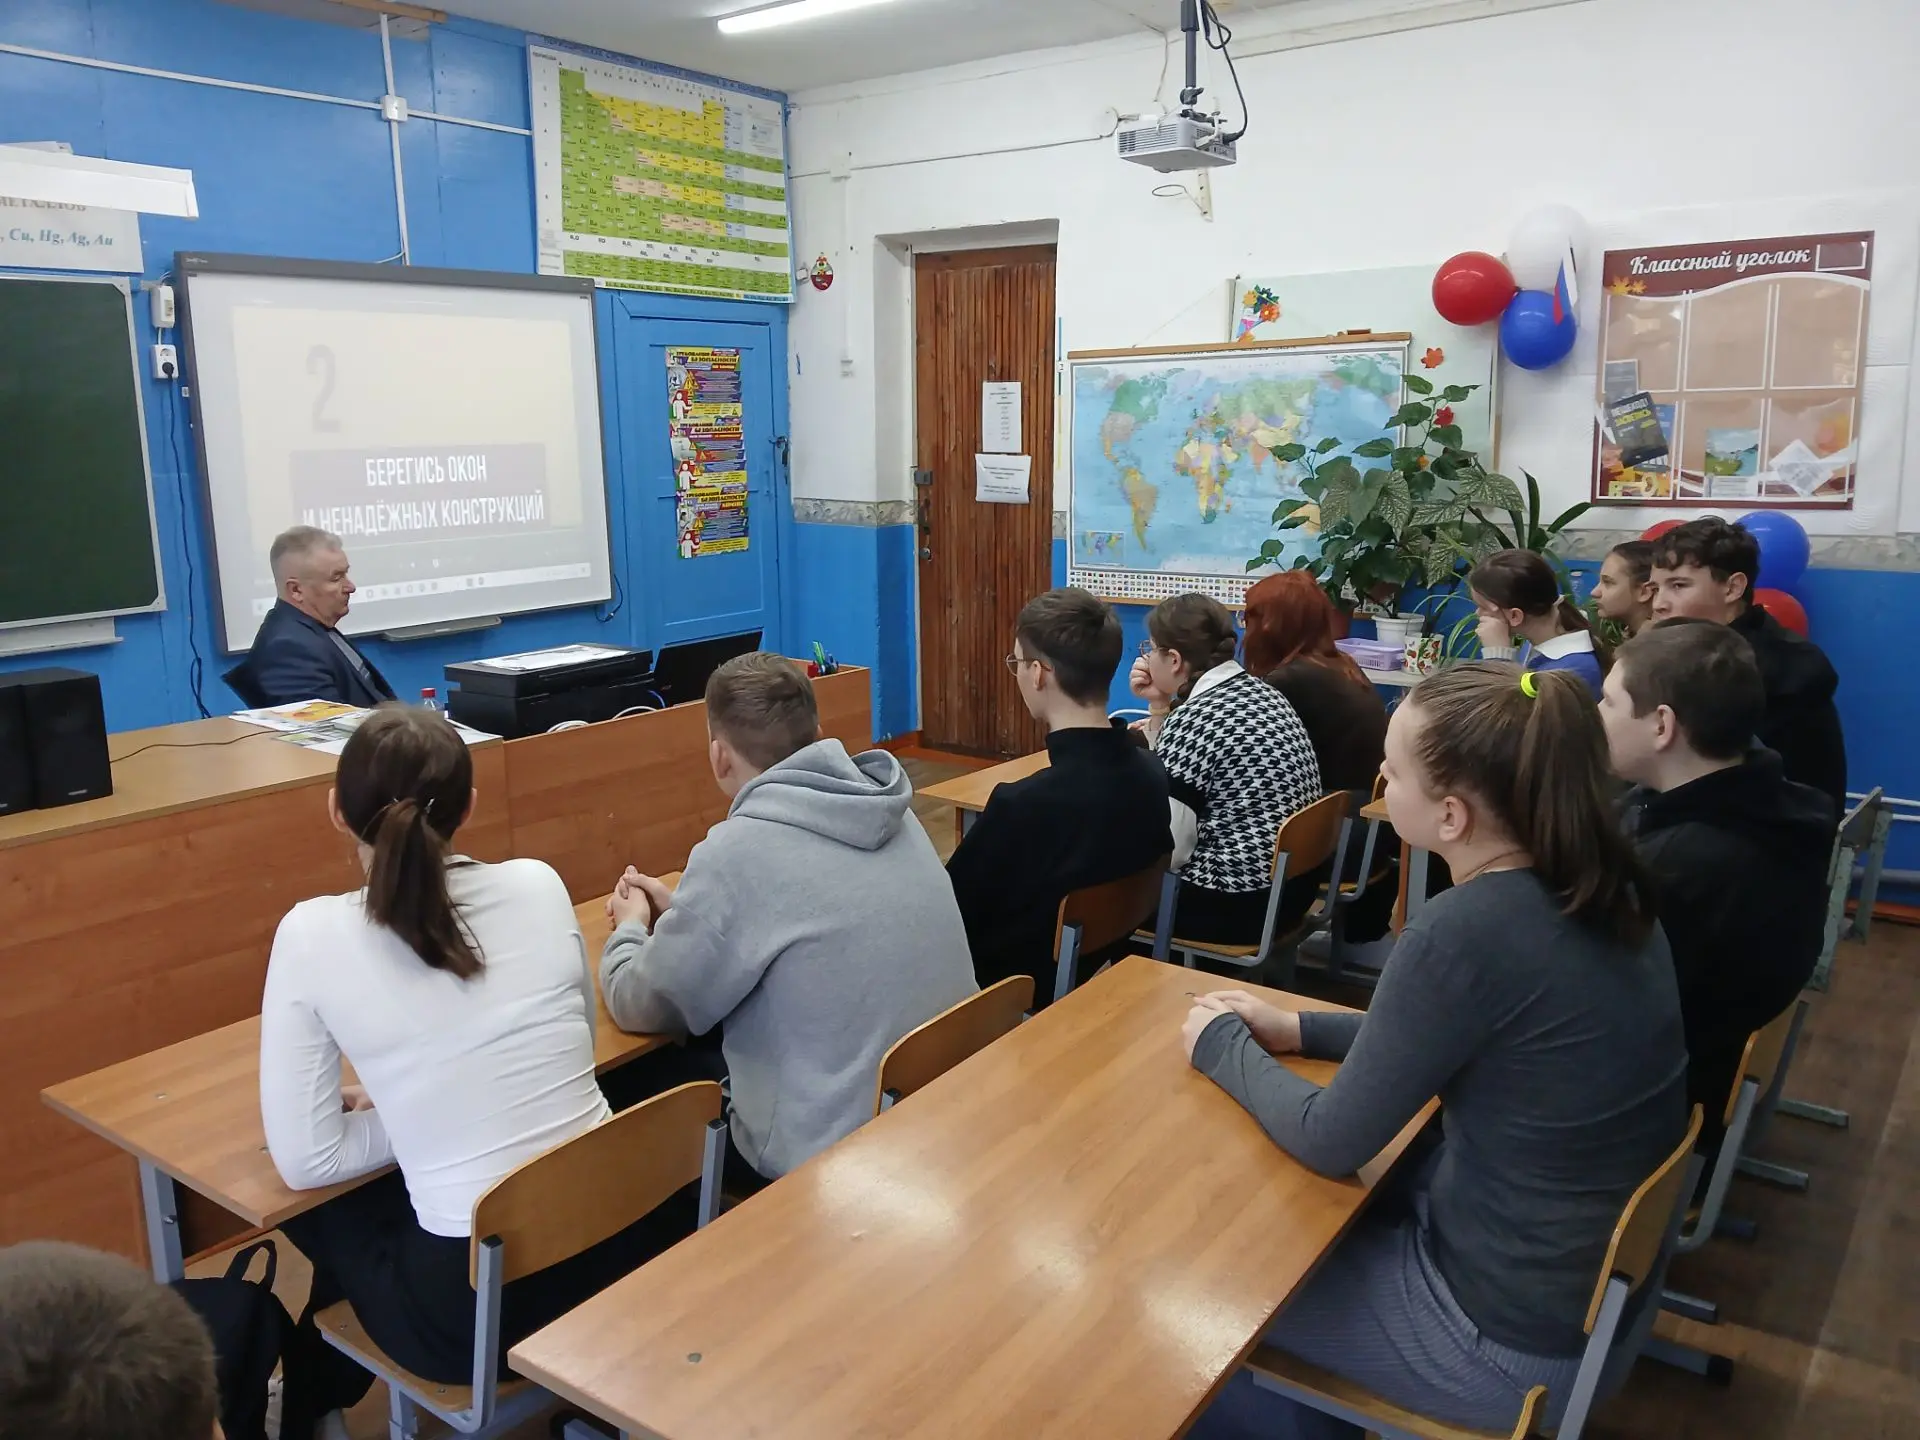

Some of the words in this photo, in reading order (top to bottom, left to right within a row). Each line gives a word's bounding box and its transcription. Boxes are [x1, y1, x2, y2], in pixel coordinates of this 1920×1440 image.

[9, 228, 35, 243] Cu,
[39, 229, 65, 245] Hg,
[67, 231, 90, 247] Ag,
[94, 233, 113, 246] Au
[1630, 250, 1733, 275] Классный
[1736, 248, 1811, 273] уголок
[305, 343, 341, 433] 2
[365, 456, 444, 487] БЕРЕГИСЬ
[448, 454, 487, 483] ОКОН
[302, 508, 314, 526] И
[319, 500, 439, 536] НЕНАДЁЖНЫХ
[441, 489, 544, 527] КОНСТРУКЦИЙ
